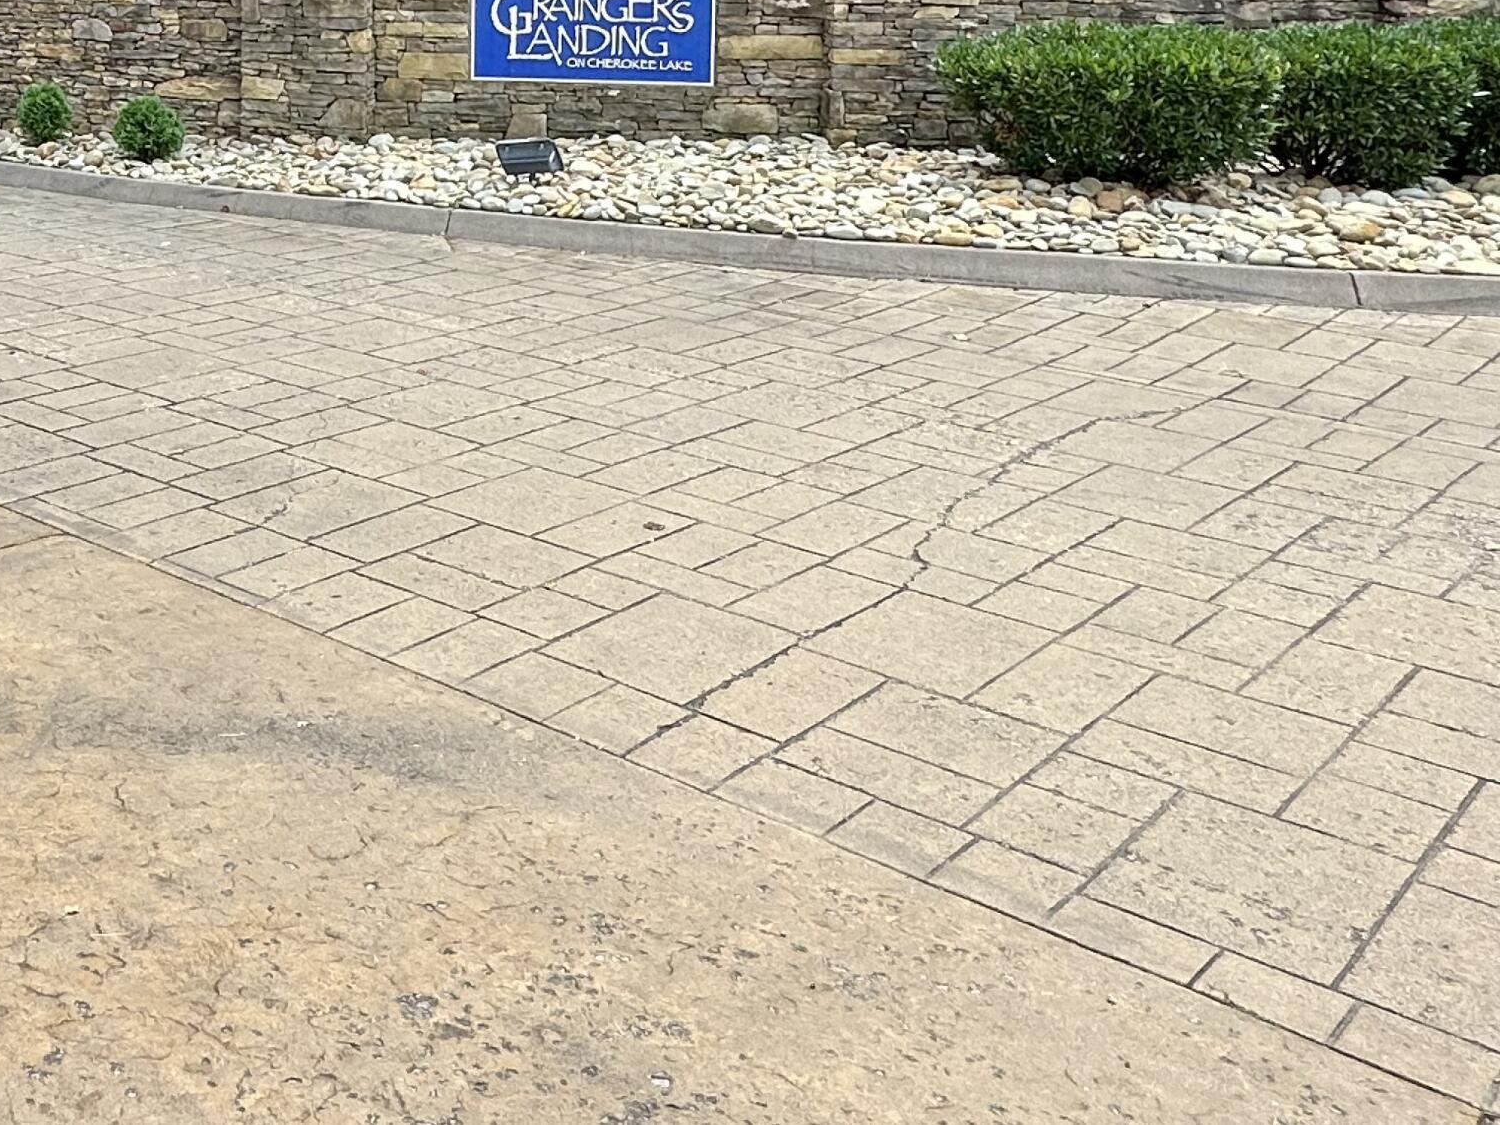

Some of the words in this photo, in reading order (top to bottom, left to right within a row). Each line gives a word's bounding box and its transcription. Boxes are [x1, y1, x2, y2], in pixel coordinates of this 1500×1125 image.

[507, 5, 670, 66] LANDING
[566, 57, 586, 68] ON
[586, 58, 657, 70] CHEROKEE
[659, 60, 693, 71] LAKE
